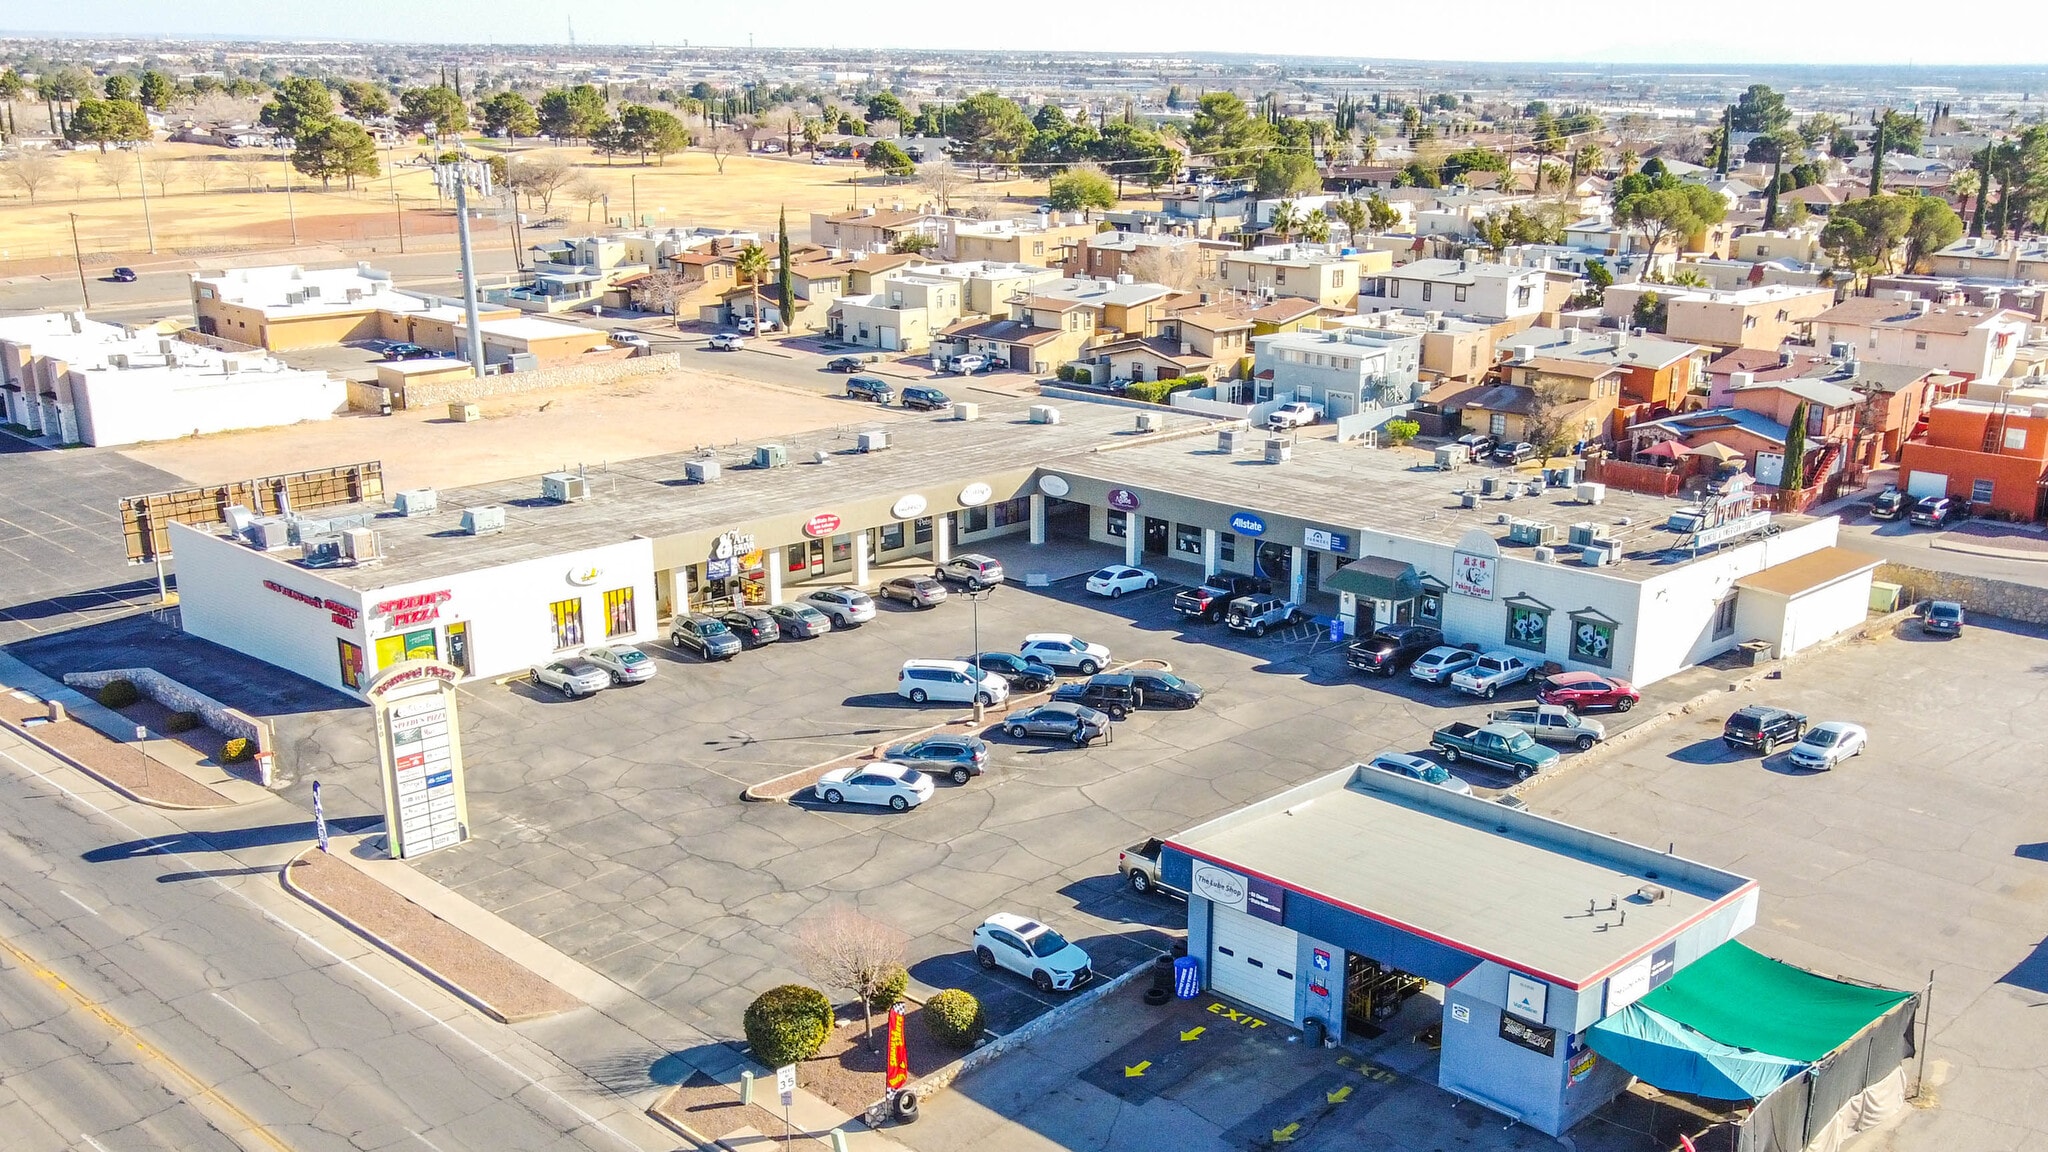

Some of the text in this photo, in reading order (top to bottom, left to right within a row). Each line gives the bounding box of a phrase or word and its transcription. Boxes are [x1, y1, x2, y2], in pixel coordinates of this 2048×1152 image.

[1717, 498, 1751, 525] PEKING
[1232, 517, 1263, 532] Allstate
[1306, 536, 1329, 545] FARMERS
[1455, 581, 1472, 592] Peking
[1472, 585, 1491, 595] Garden
[377, 589, 452, 614] SPEEDY'S
[393, 607, 440, 627] PIZZA
[426, 711, 446, 723] PIZZA
[1198, 874, 1242, 897] The Lube Shop
[1206, 1002, 1267, 1029] EXIT
[780, 1077, 795, 1090] 35
